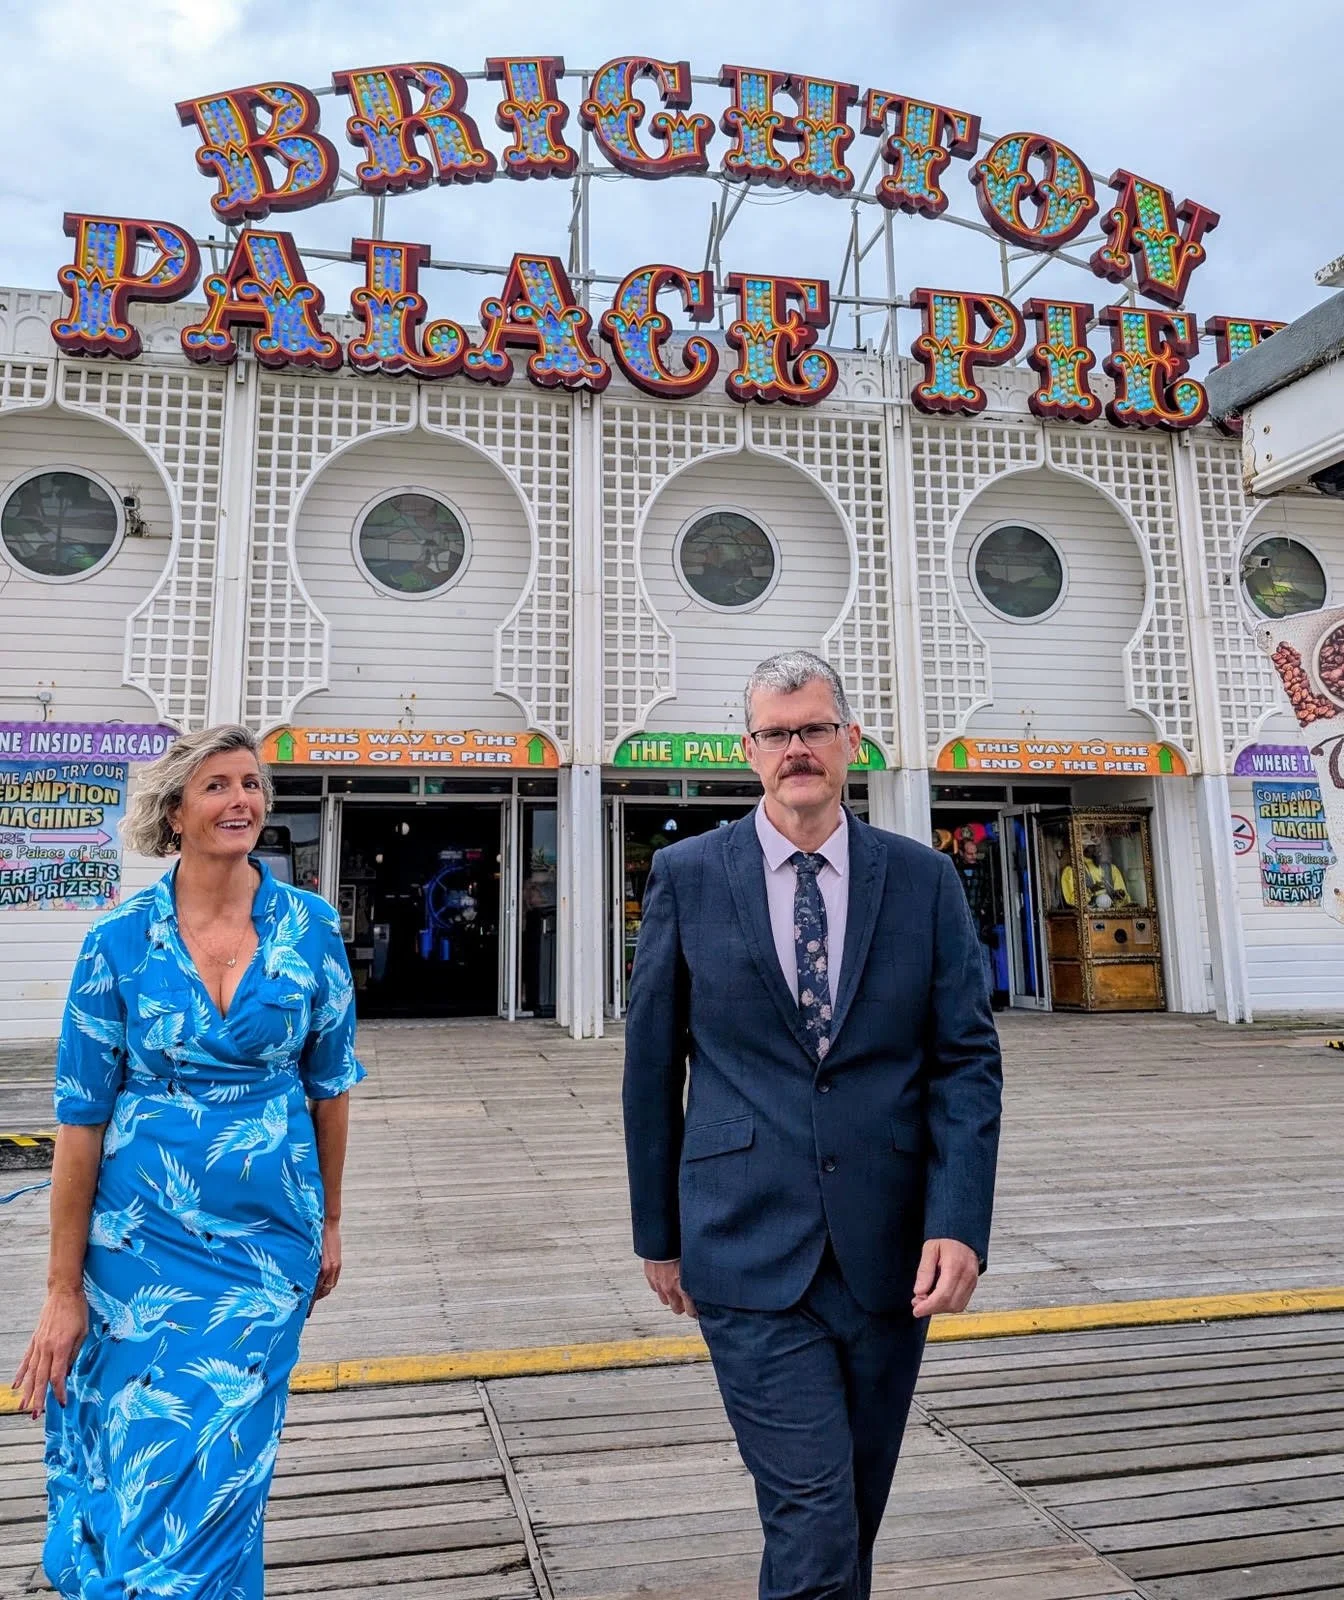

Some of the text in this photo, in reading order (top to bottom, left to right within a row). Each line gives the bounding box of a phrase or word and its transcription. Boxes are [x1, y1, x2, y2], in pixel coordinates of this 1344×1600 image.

[175, 56, 1220, 307] BRIGHTON
[51, 213, 838, 406] PALACE
[0, 732, 22, 752] NE
[29, 732, 93, 754] INSIDE
[305, 733, 516, 746] THIS WAY TO THE
[309, 749, 512, 763] END OF THE PIER
[627, 740, 672, 761] THE
[975, 743, 1149, 757] THIS WAY TO THE
[980, 759, 1147, 772] END OF THE PIER
[1252, 754, 1298, 772] WHERE
[23, 768, 57, 784] AND
[61, 764, 89, 778] TRY
[93, 764, 125, 780] OUR
[1256, 789, 1288, 802] COME
[1290, 788, 1312, 801] AND
[1260, 800, 1325, 818] REDEMP
[0, 832, 26, 845] RE
[16, 845, 65, 860] Palace
[69, 845, 87, 861] of
[90, 845, 118, 860] Fun
[1262, 852, 1274, 865] In
[1275, 853, 1293, 865] the
[1295, 852, 1329, 865] Palace
[1, 862, 119, 884] ERE TICKETS
[1263, 871, 1312, 887] WHERE
[33, 881, 100, 901] PRIZES
[1270, 886, 1311, 902] MEAN
